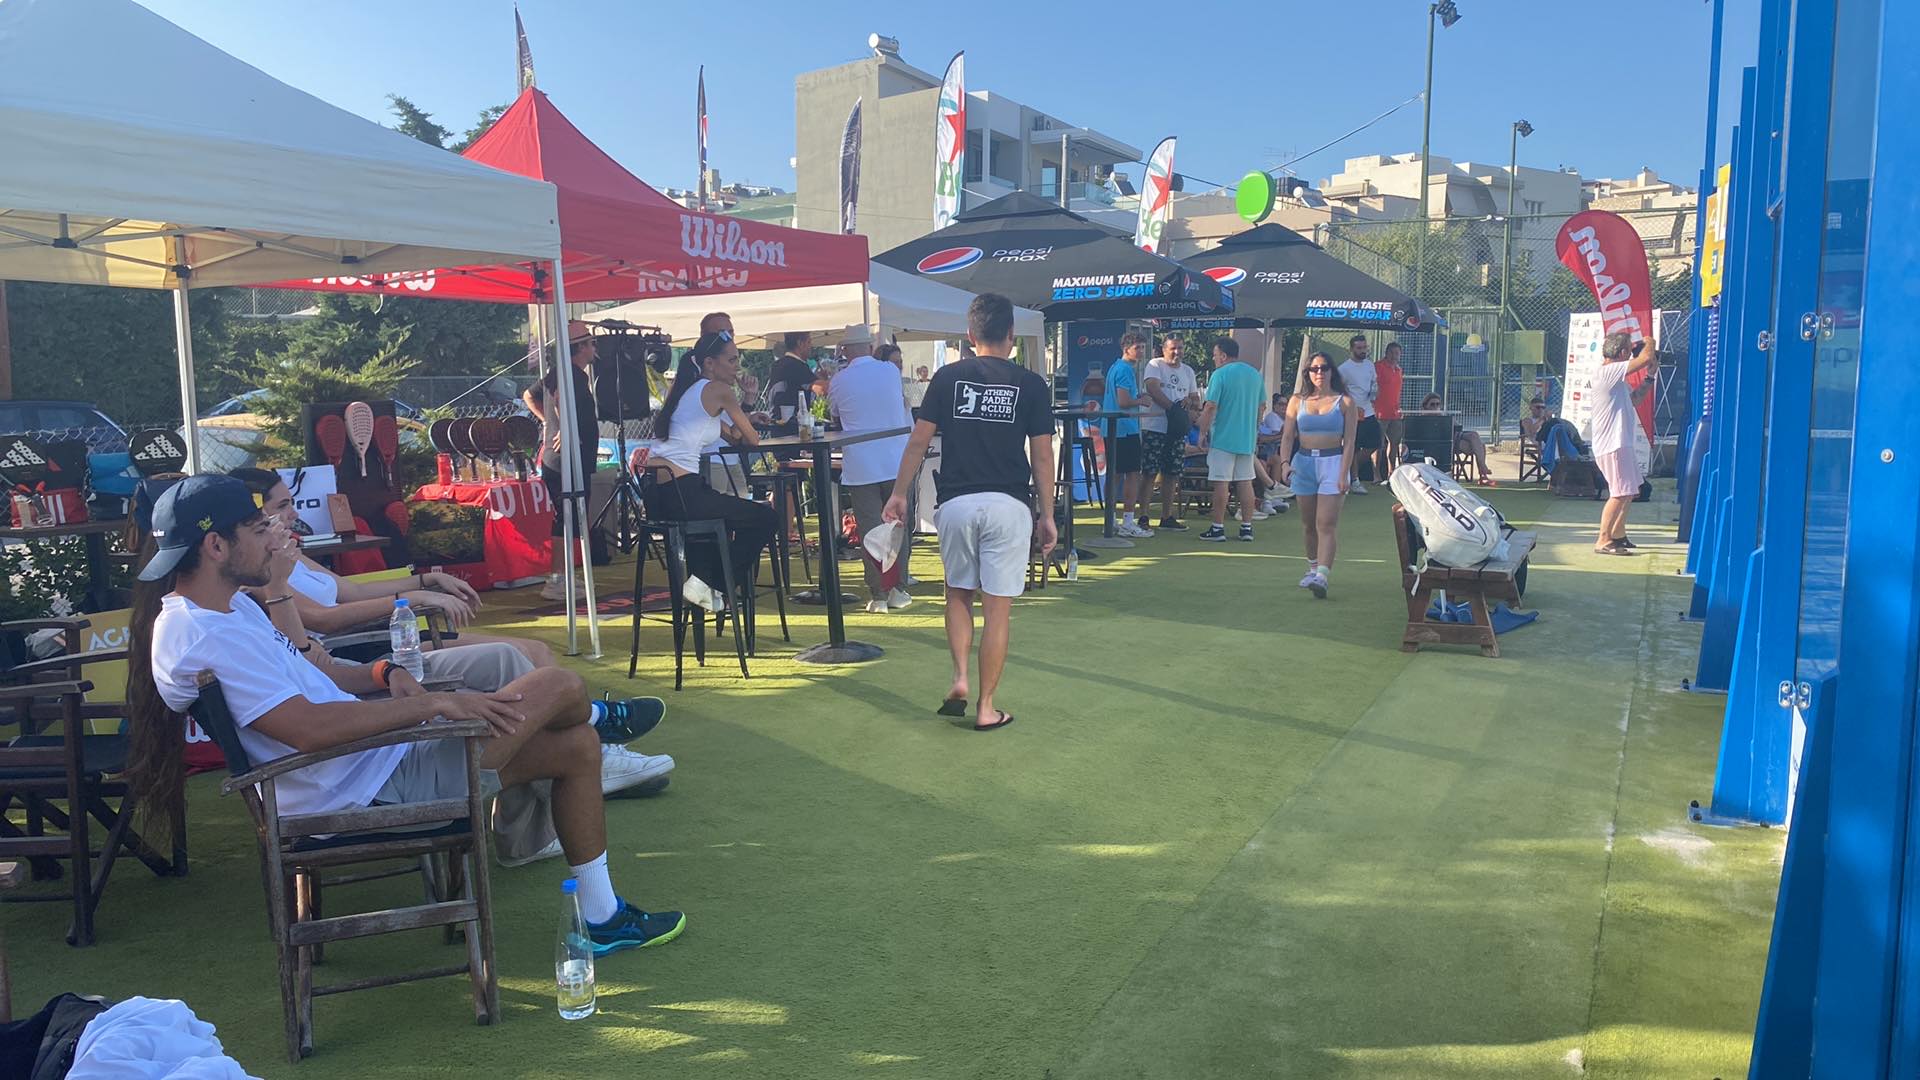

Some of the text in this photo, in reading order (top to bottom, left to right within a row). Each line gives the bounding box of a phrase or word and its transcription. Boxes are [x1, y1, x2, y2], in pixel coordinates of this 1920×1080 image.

[680, 213, 788, 269] Wilson
[992, 245, 1053, 257] pepsi
[999, 254, 1048, 262] max
[1052, 272, 1155, 288] MAXIMUM TASTE
[1254, 271, 1305, 279] pepsi
[1052, 283, 1154, 300] ZERO SUGAR
[1306, 300, 1393, 310] MAXIMUM TASTE
[1305, 308, 1392, 320] ZERO SUGAR
[983, 389, 1014, 397] ATHENS
[981, 396, 1013, 405] PADEL
[291, 498, 320, 509] ro
